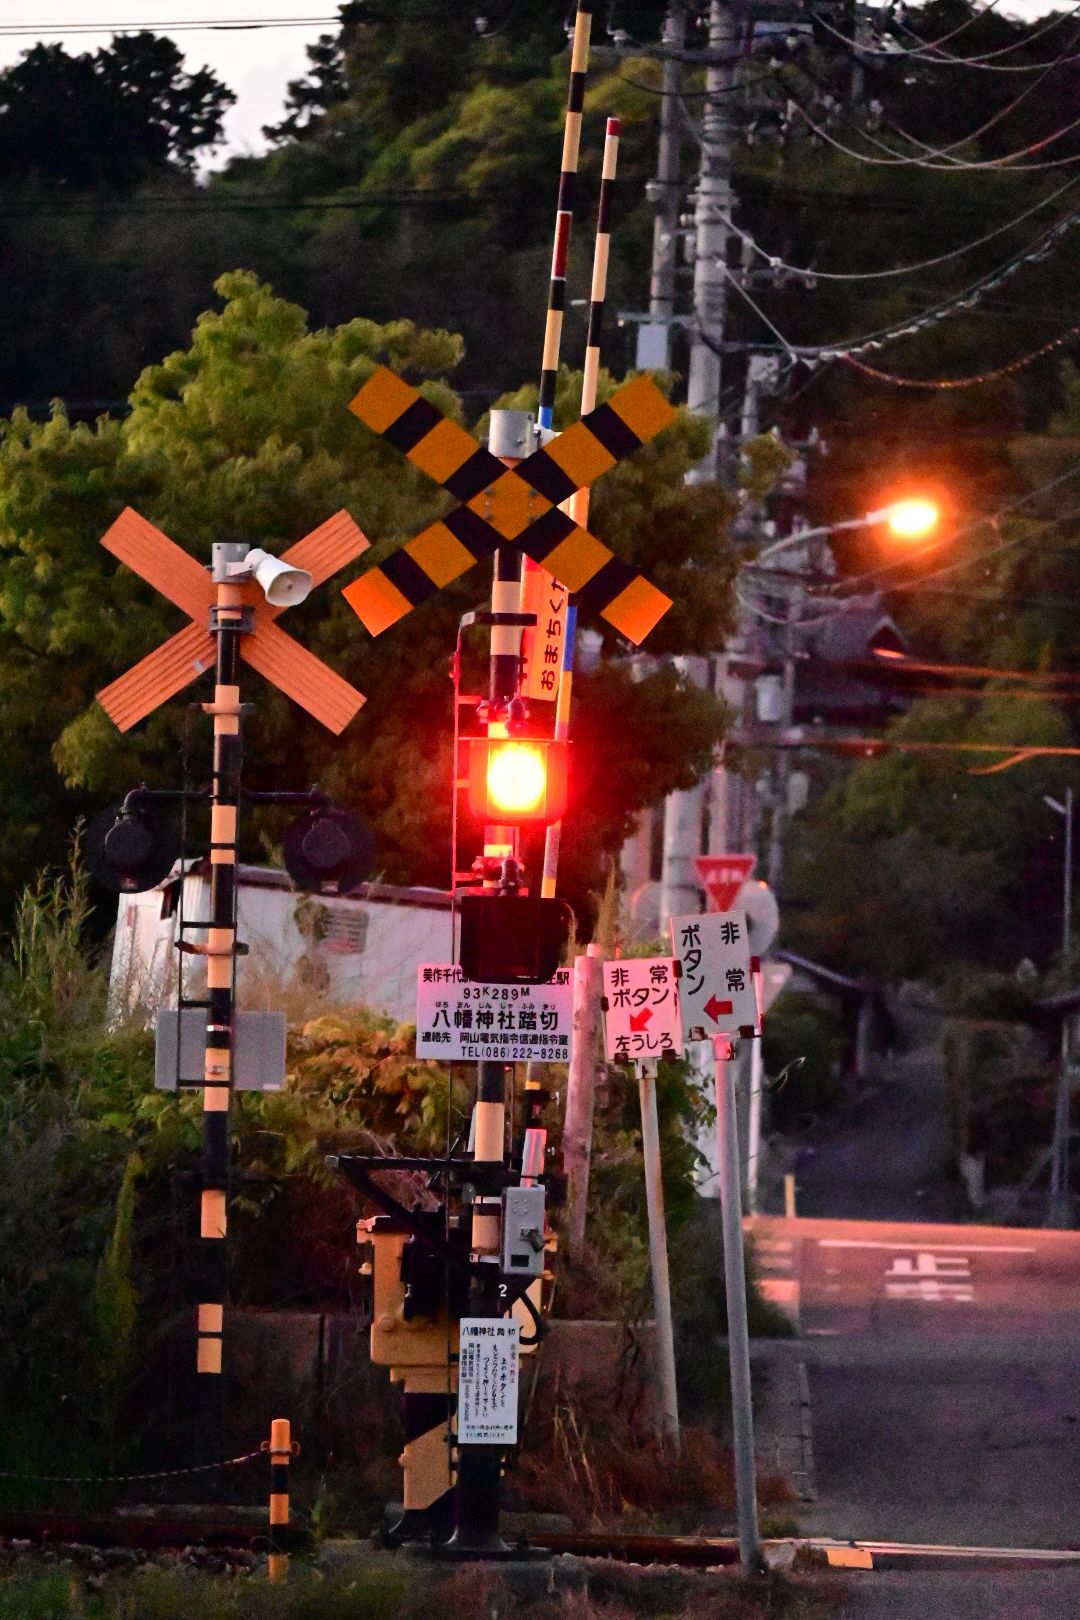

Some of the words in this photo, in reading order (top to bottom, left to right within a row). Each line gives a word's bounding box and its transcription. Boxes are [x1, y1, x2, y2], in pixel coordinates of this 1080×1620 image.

[681, 924, 705, 996] ボタン
[423, 968, 472, 984] 美作千代
[612, 987, 669, 1008] ボタン
[432, 1009, 558, 1031] 八幡神社踏切
[422, 1032, 451, 1043] 連絡先
[615, 1032, 673, 1052] 左うしろ
[498, 1283, 508, 1298] 2
